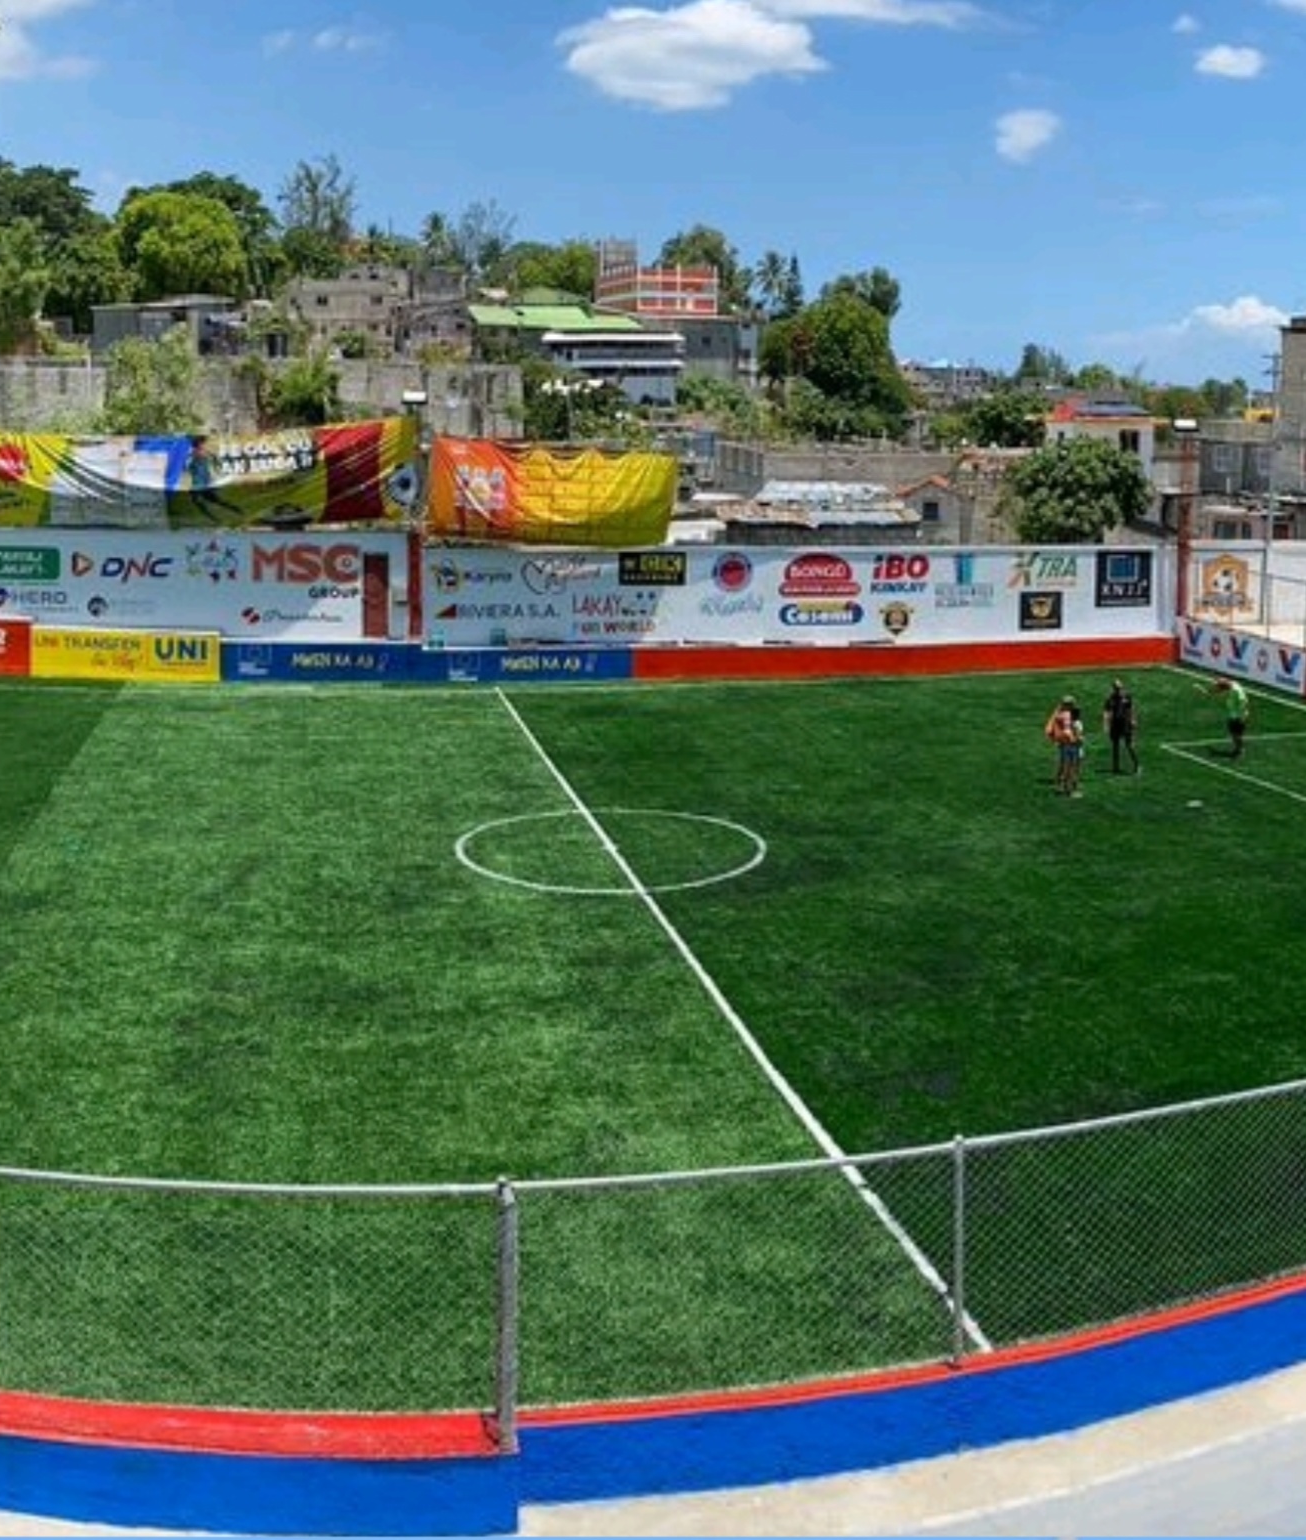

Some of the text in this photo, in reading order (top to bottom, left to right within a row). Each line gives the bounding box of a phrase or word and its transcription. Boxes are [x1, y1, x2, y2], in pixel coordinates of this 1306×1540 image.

[101, 554, 173, 583] DNC
[252, 544, 361, 584] MSC
[309, 586, 359, 599] GROUP
[155, 637, 208, 660] UNI
